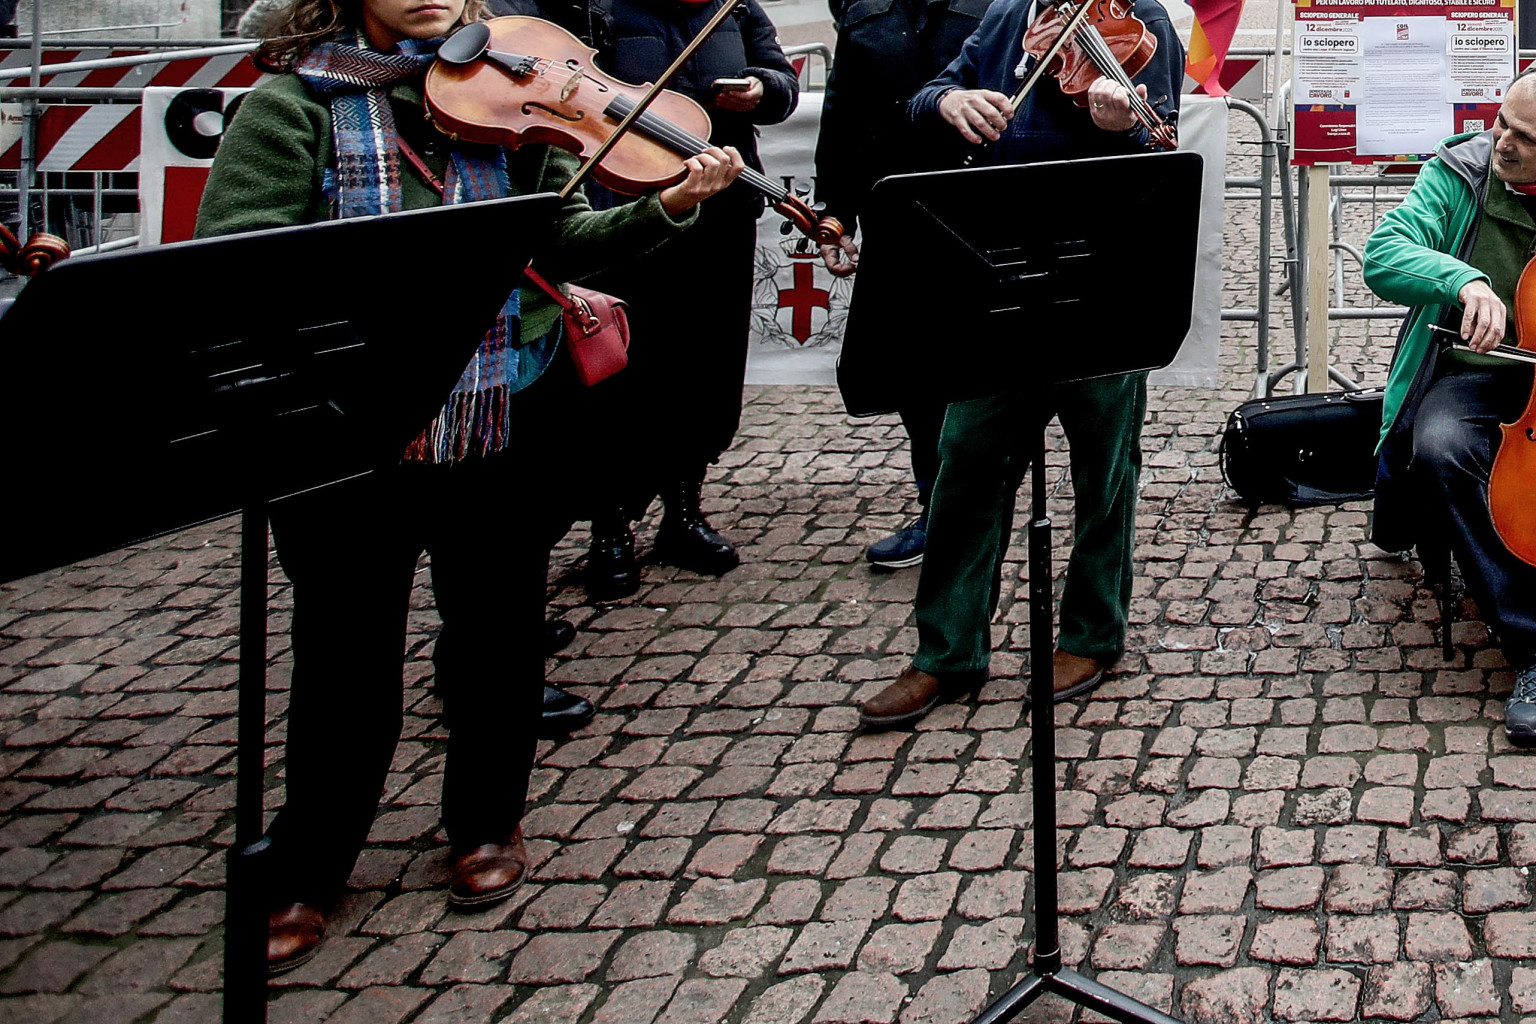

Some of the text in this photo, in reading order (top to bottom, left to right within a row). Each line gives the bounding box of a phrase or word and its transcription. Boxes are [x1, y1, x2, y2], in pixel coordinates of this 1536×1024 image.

[1306, 23, 1316, 32] 12
[1456, 23, 1466, 31] 12
[1303, 37, 1354, 48] io sciopero
[1455, 37, 1505, 47] io sciopero
